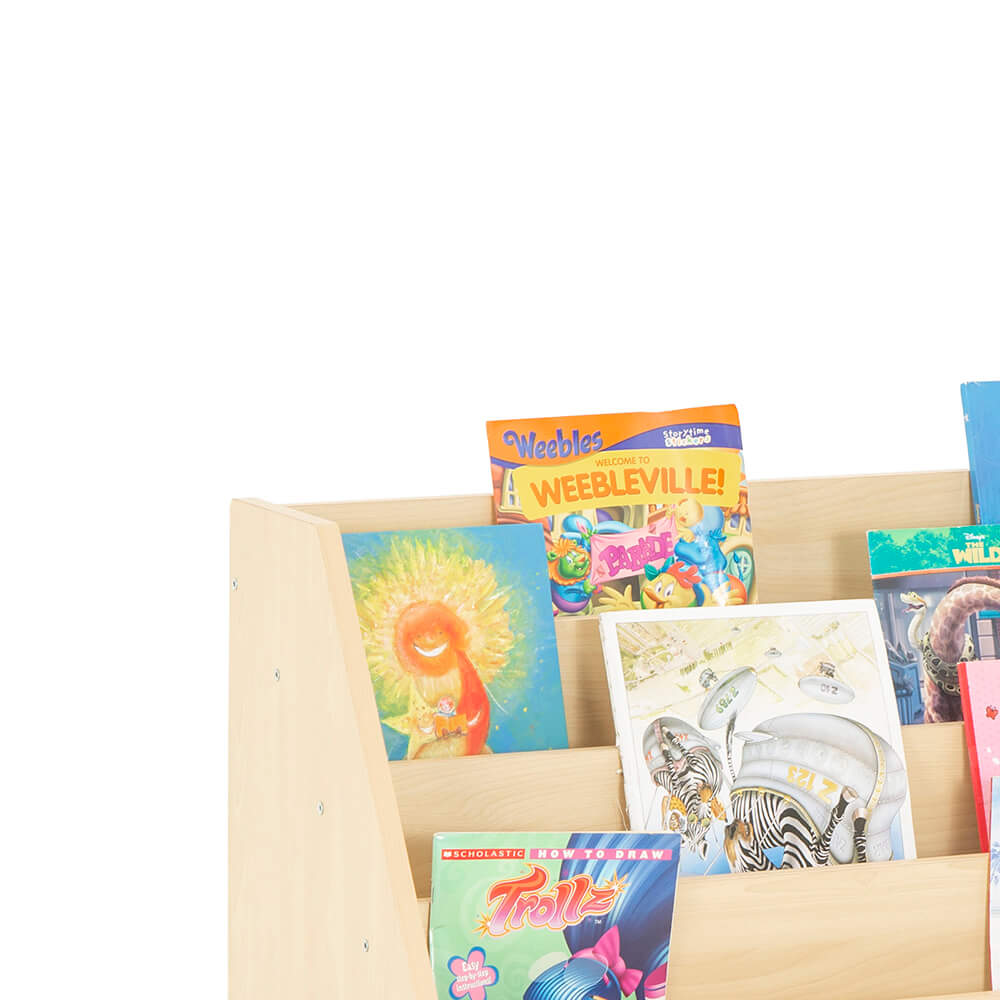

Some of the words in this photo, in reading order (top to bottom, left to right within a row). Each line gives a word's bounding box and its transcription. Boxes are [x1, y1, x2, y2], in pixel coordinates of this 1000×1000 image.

[503, 429, 603, 460] Weebles
[595, 457, 637, 467] WELCOME
[638, 456, 650, 465] TO
[530, 467, 725, 508] WEEBLEVILLE!
[601, 531, 674, 577] PARADE
[787, 765, 815, 791] 123
[454, 850, 523, 858] SCHOLASTIC
[538, 850, 575, 859] HOW
[584, 850, 605, 859] TO
[616, 850, 665, 860] DRAW
[487, 863, 618, 936] Trollz
